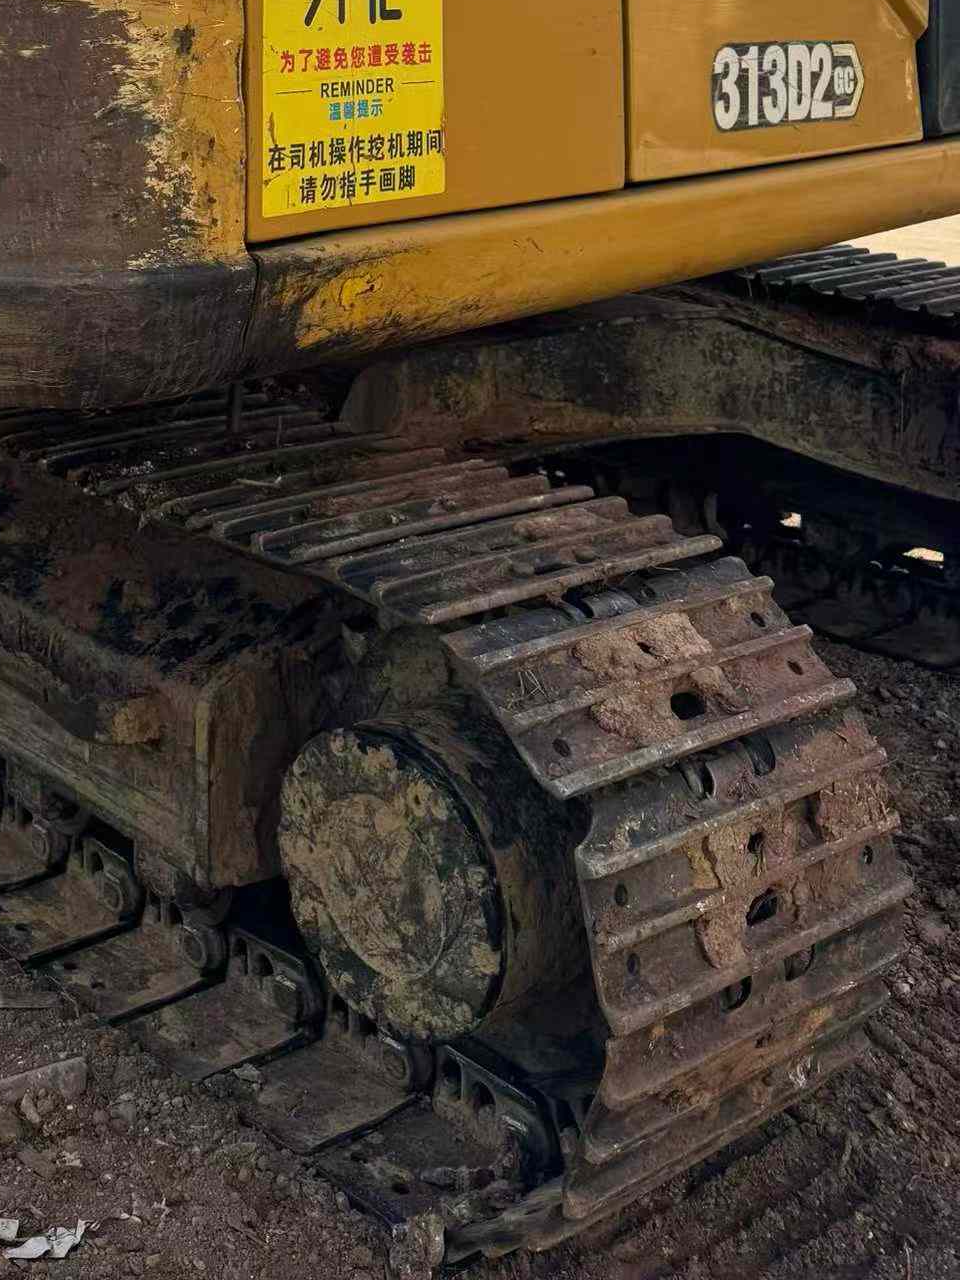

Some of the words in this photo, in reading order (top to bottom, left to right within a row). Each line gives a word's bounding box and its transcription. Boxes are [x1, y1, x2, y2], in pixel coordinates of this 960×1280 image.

[320, 77, 394, 98] REMINDER
[714, 43, 833, 130] 313D2
[834, 66, 854, 96] GC
[329, 99, 383, 121] 温馨提示
[268, 129, 442, 173] 在司机操作挖机期间
[299, 165, 416, 203] 请勿指手画脚
